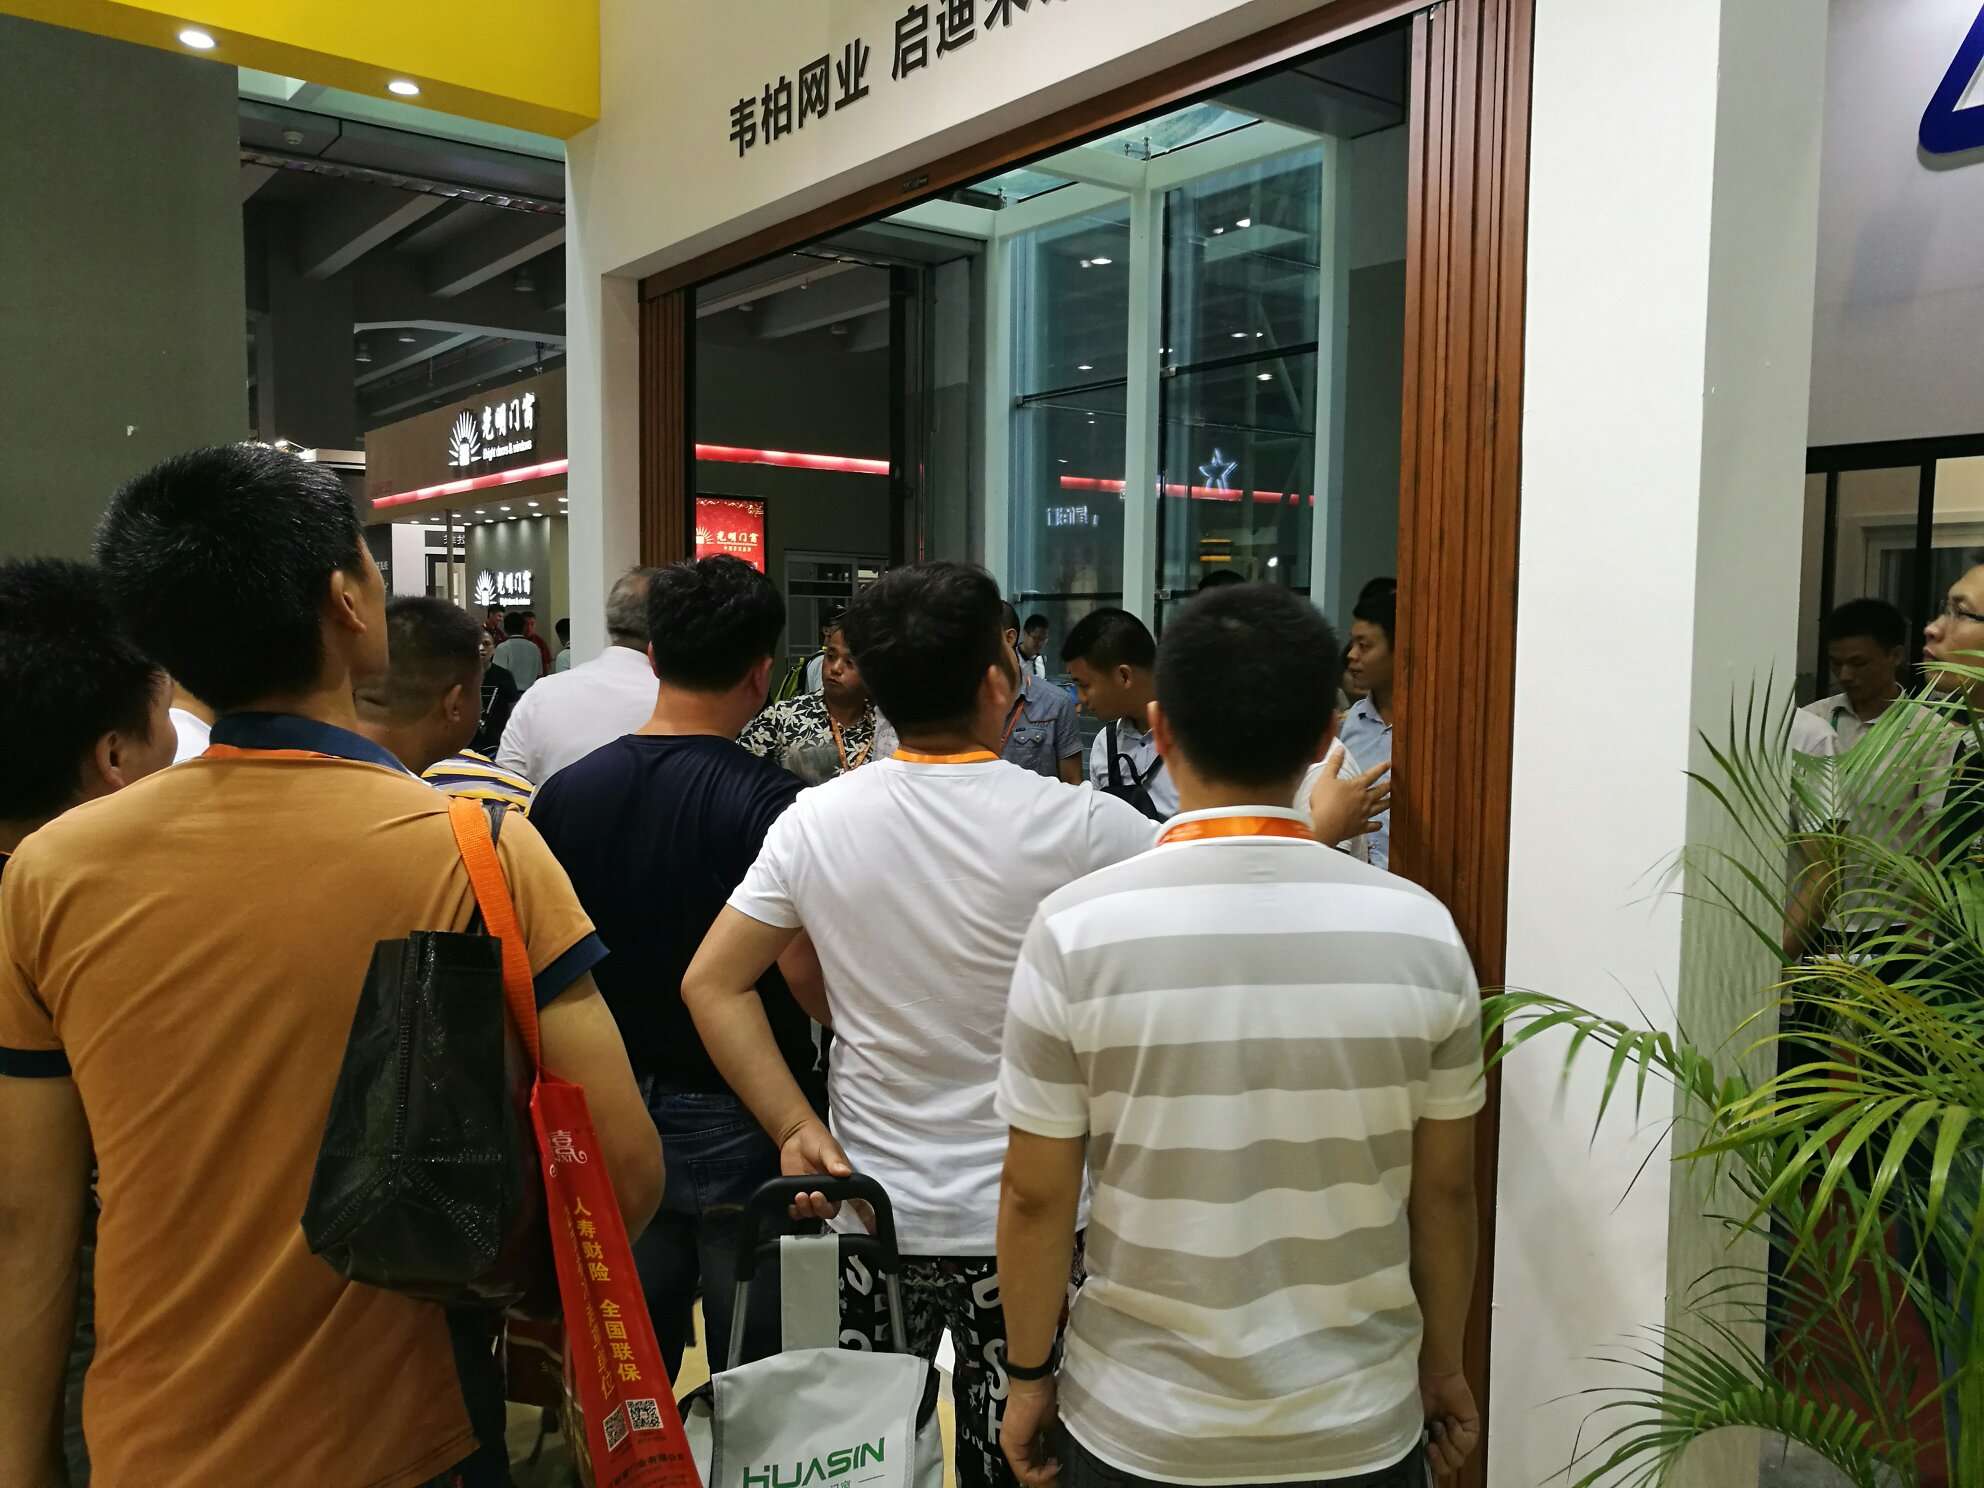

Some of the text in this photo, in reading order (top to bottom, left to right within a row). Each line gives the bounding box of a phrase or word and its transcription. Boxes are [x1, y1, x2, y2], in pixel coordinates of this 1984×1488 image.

[729, 0, 1070, 158] 韦柏网业 启迪
[573, 1197, 611, 1282] 人寿财险
[599, 1299, 642, 1383] 全国联保
[743, 1437, 885, 1488] HUASIN
